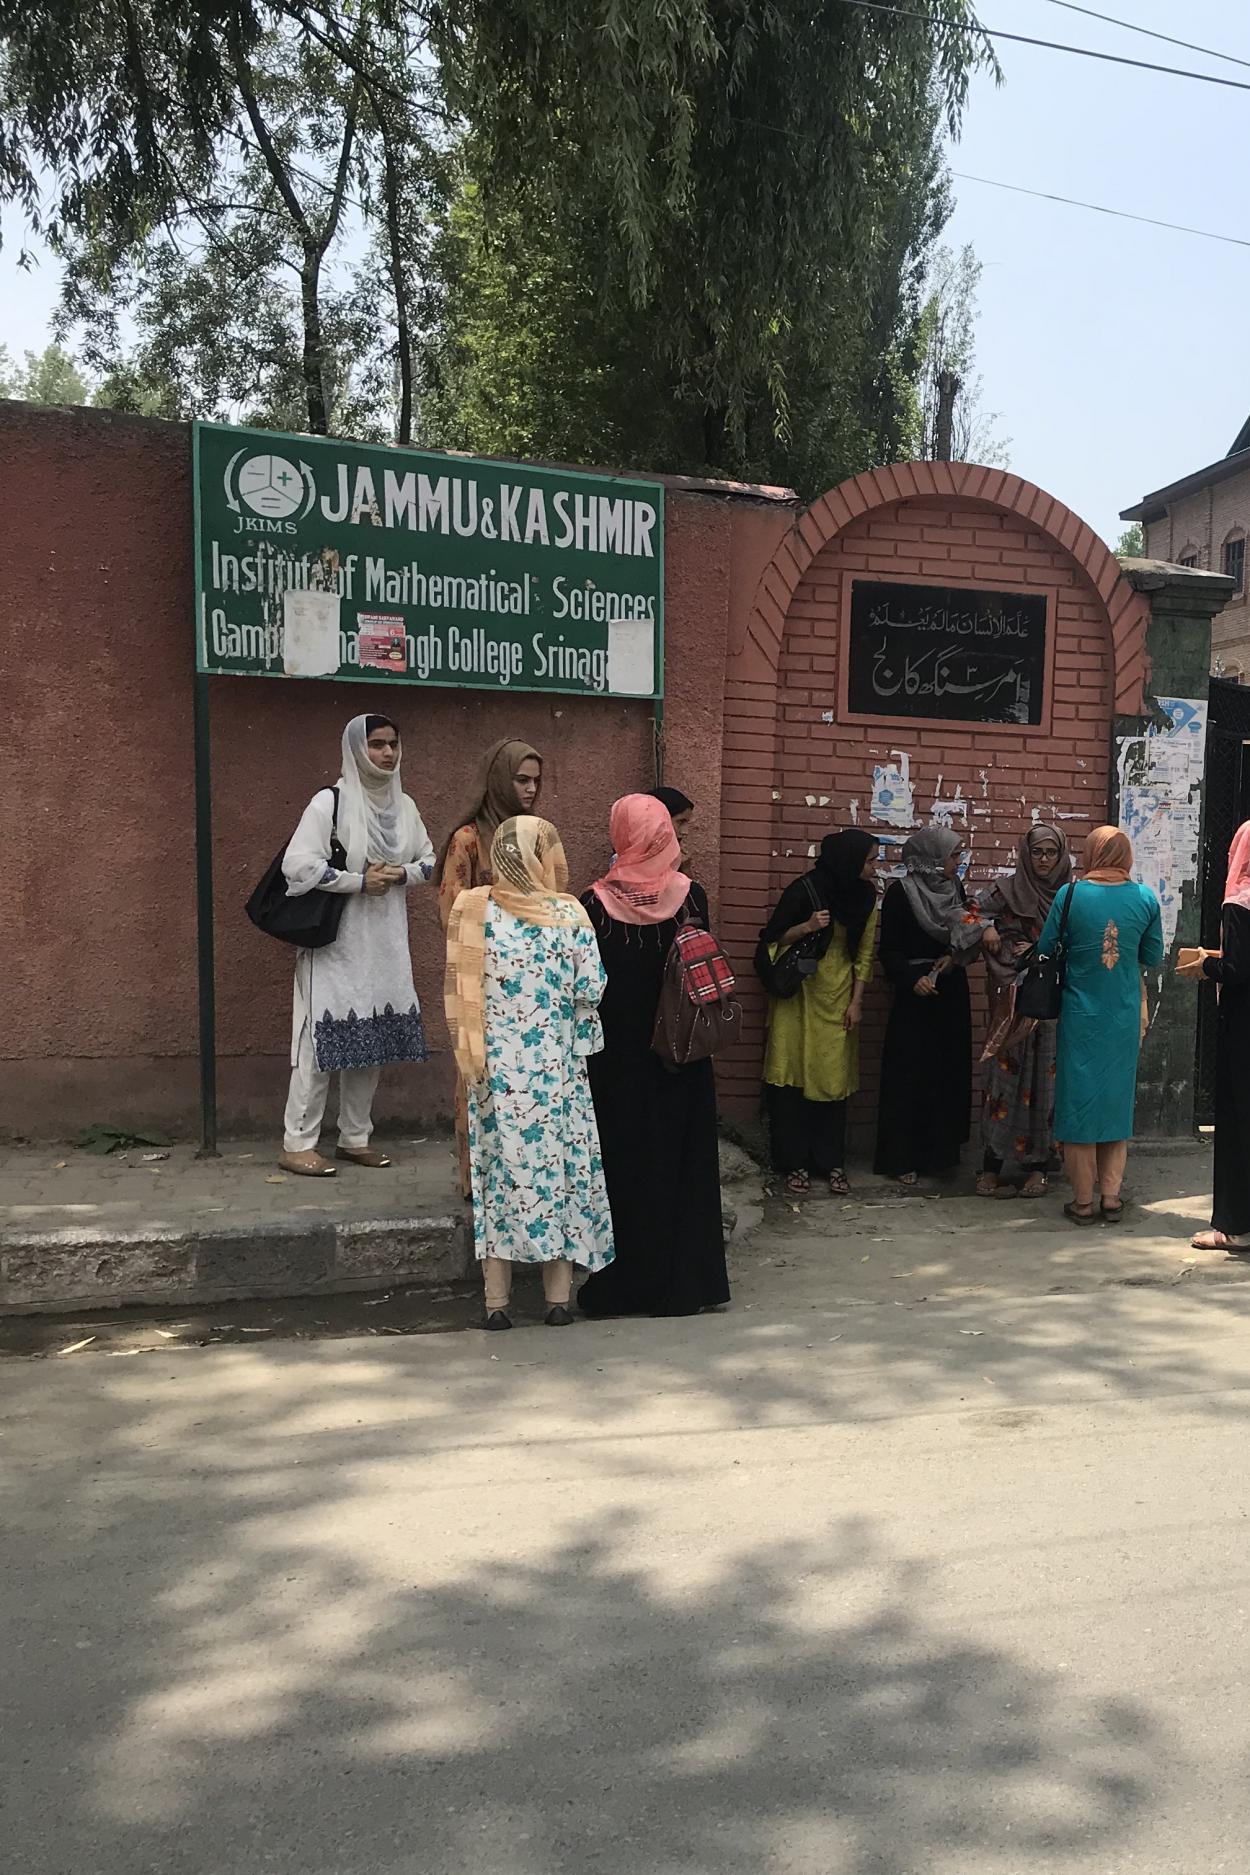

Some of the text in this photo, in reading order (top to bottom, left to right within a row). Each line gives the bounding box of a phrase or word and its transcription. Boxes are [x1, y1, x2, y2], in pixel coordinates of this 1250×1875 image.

[233, 516, 298, 535] JKIMS
[365, 556, 529, 615] Mathematical
[552, 575, 655, 622] Sciences
[211, 608, 285, 670] Camp
[405, 625, 442, 679] ngh
[448, 626, 523, 685] College
[532, 632, 609, 692] Srinag
